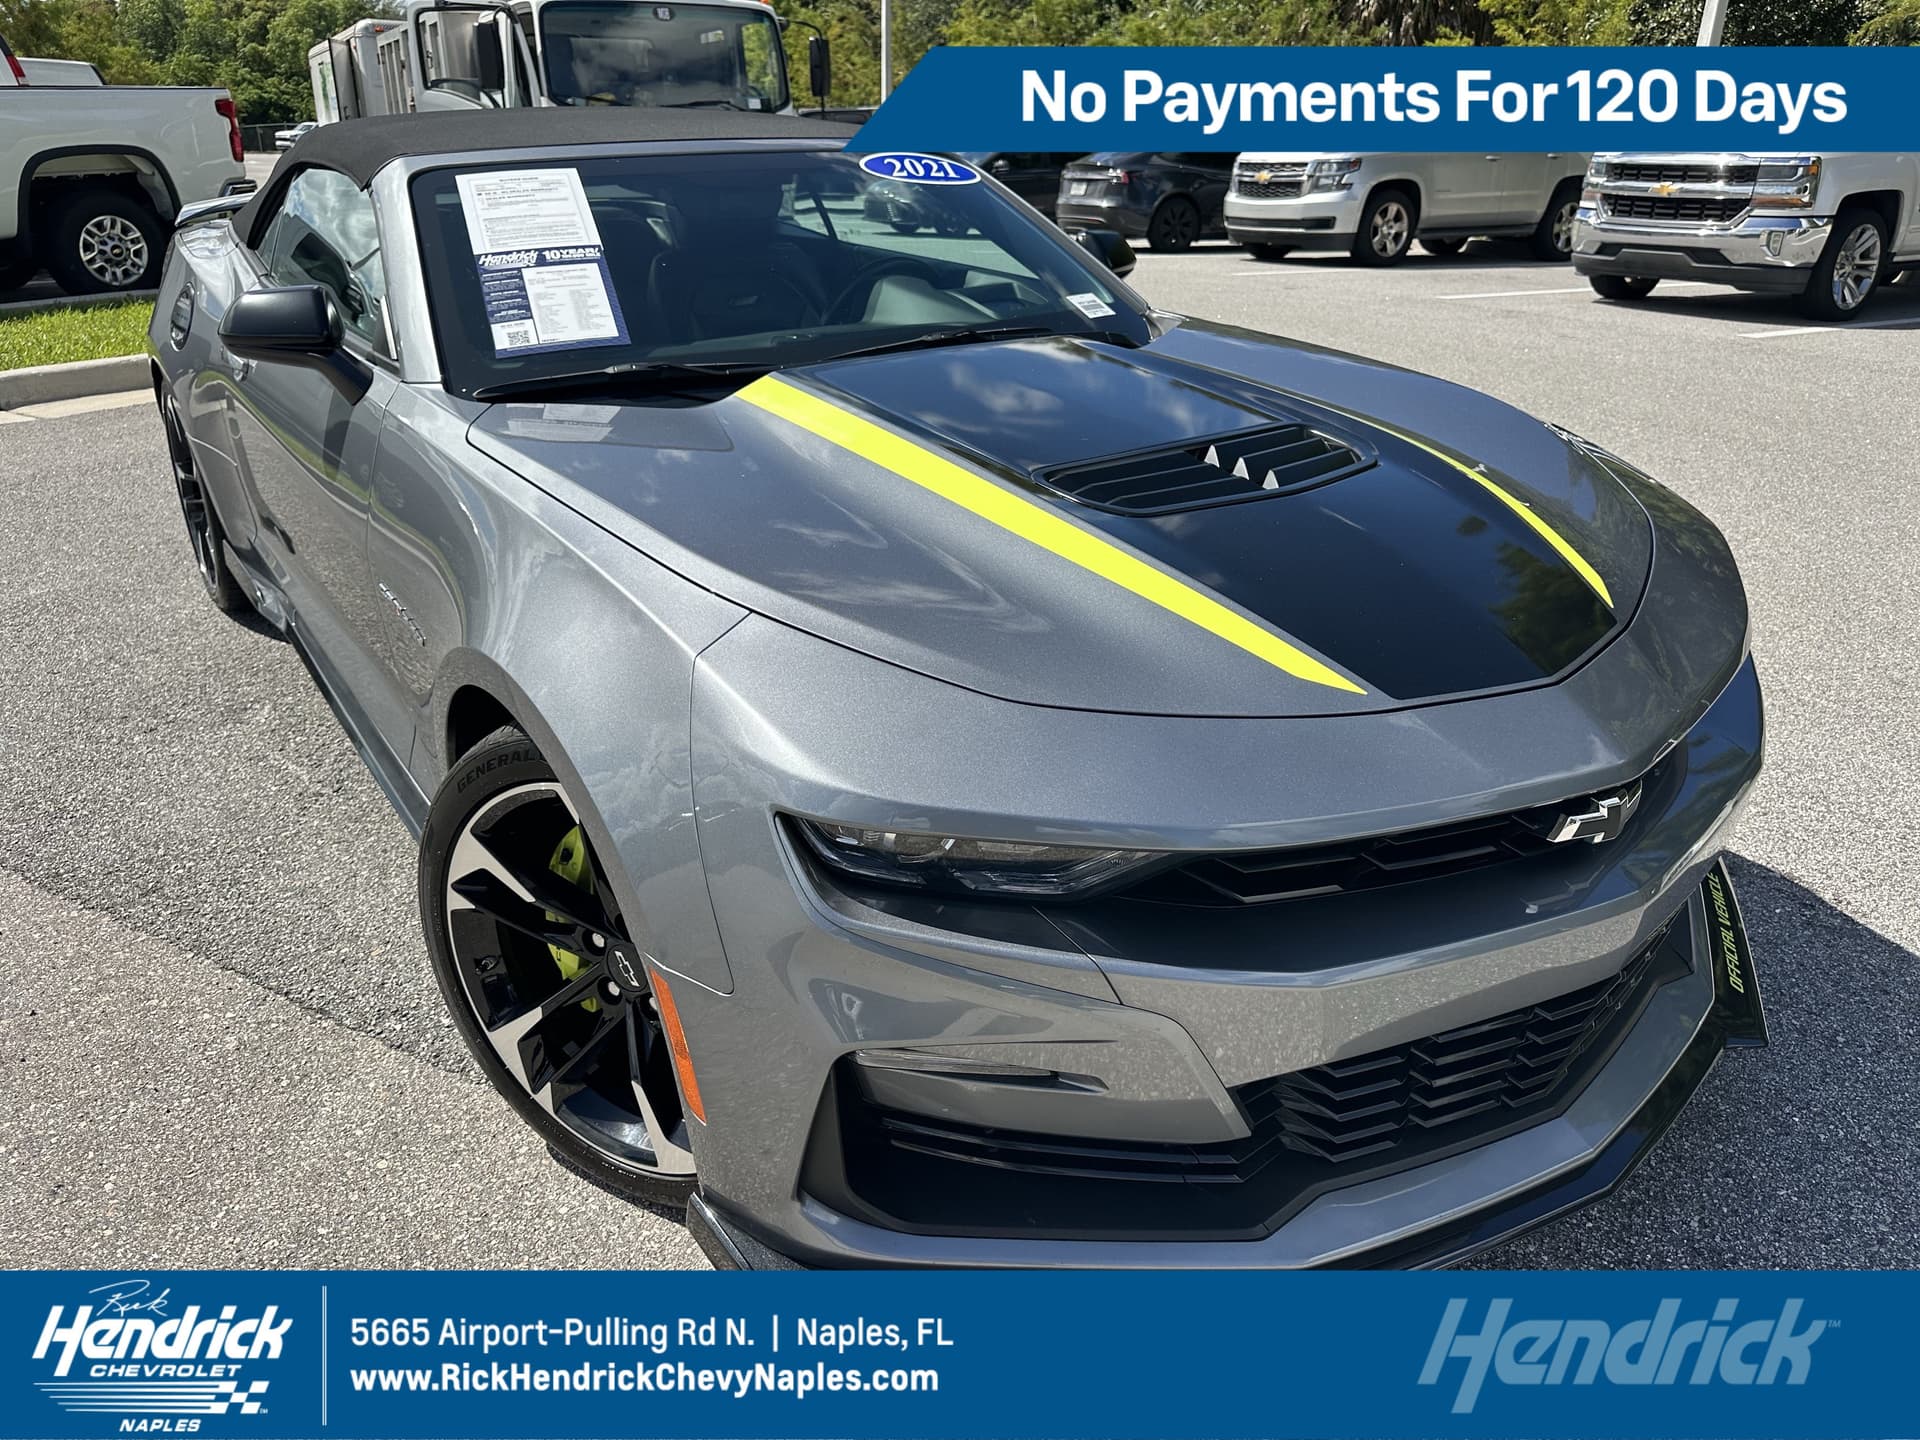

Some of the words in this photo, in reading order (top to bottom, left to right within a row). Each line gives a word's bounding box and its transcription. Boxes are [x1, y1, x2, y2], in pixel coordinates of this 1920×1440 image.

[884, 158, 960, 178] 2021
[479, 249, 538, 267] Hendrick
[542, 250, 560, 260] 10
[456, 749, 536, 794] GENERAL
[1706, 871, 1732, 927] VEHICLE
[1720, 926, 1745, 994] OFFICIAL
